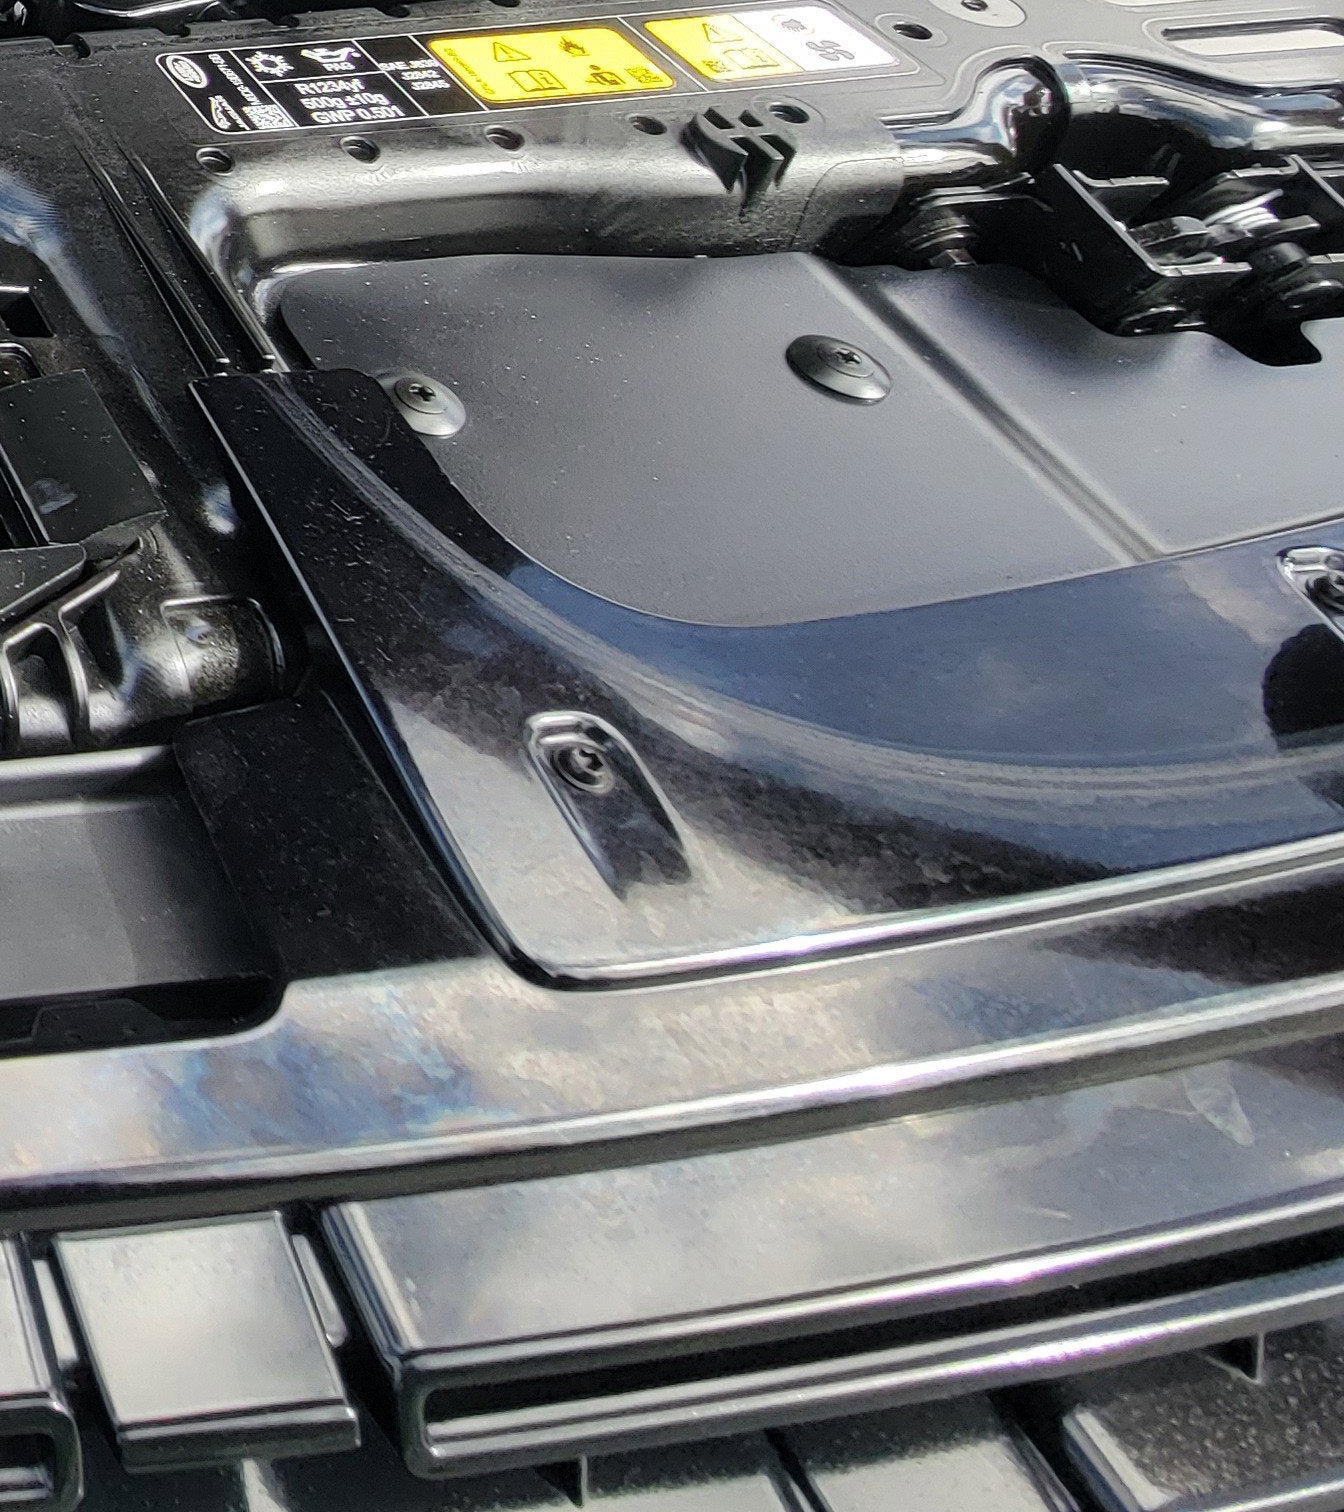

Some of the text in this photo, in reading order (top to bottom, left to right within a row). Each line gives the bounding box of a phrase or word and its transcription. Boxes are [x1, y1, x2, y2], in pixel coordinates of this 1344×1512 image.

[293, 78, 366, 95] R1234yf
[299, 92, 391, 110] 500g ±10g
[310, 104, 406, 124] GWP 0.501
